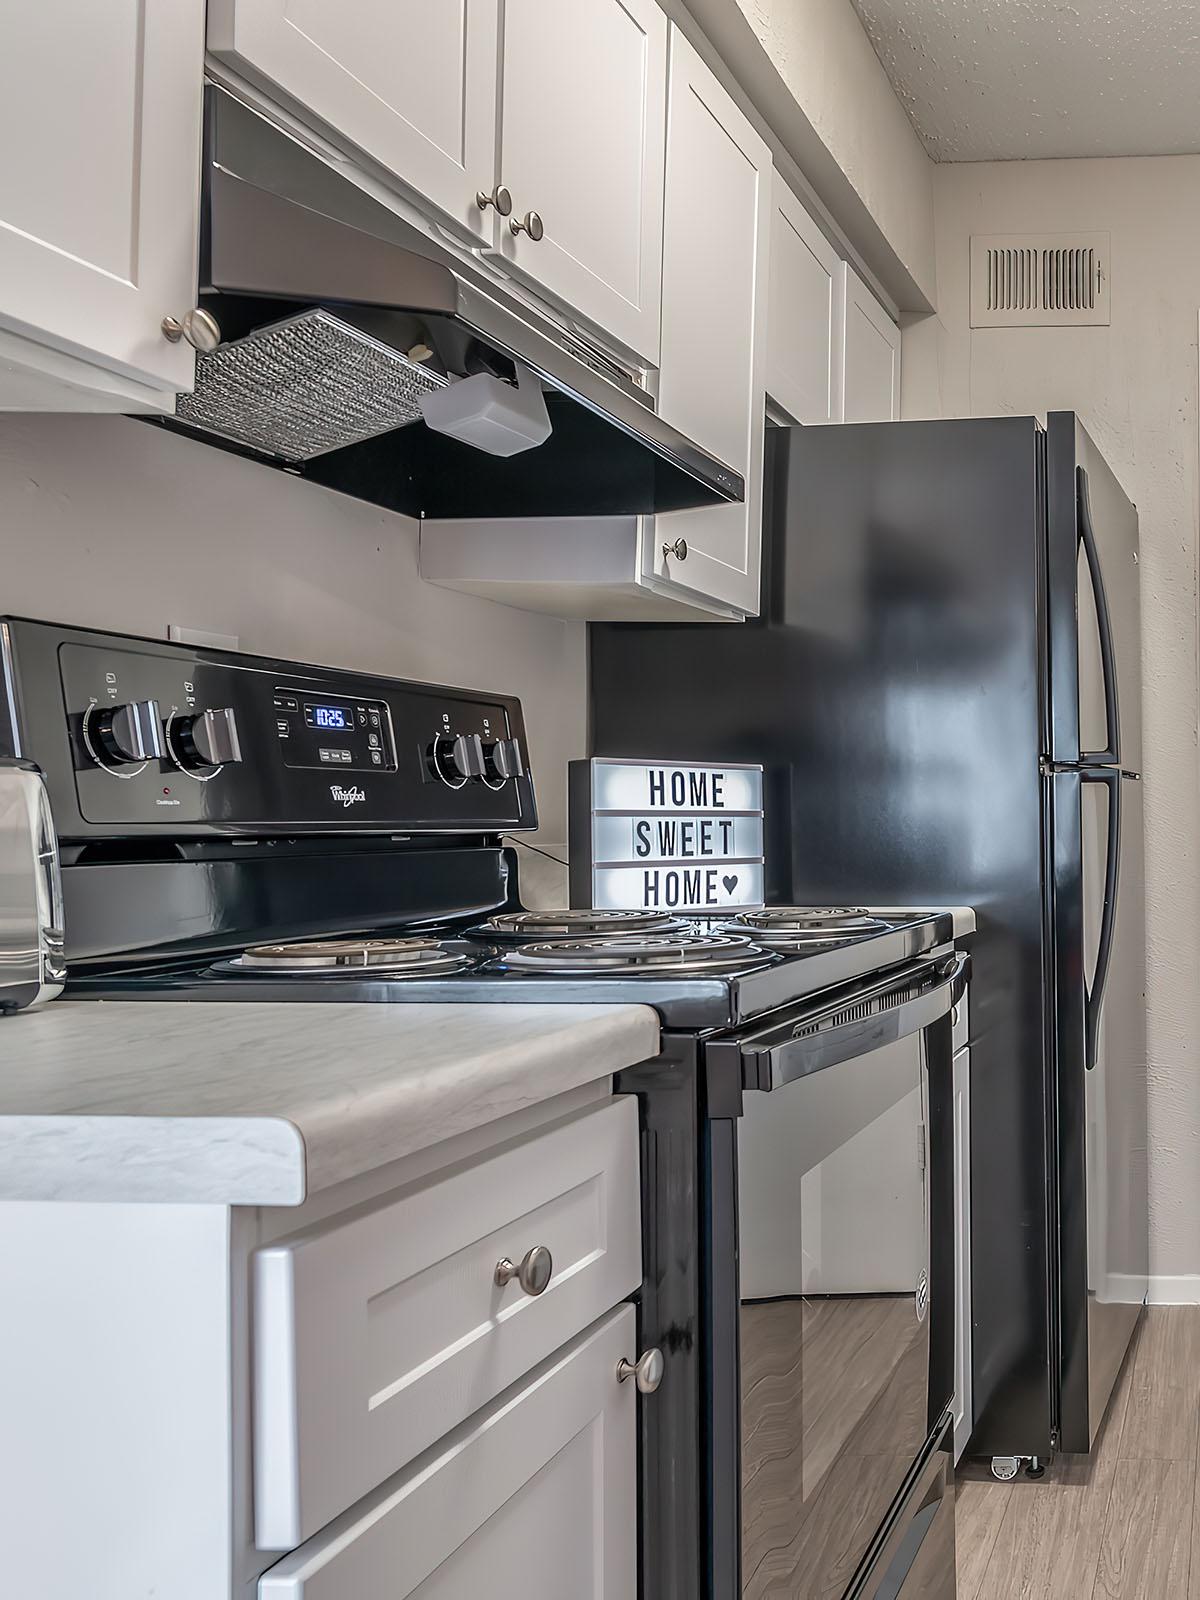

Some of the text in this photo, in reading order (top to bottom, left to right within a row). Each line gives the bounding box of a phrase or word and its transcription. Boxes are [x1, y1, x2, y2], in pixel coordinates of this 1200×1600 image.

[329, 785, 366, 808] Whirlpool
[649, 770, 725, 808] HOME
[636, 820, 732, 857] SWEET
[643, 870, 718, 907] HOME
